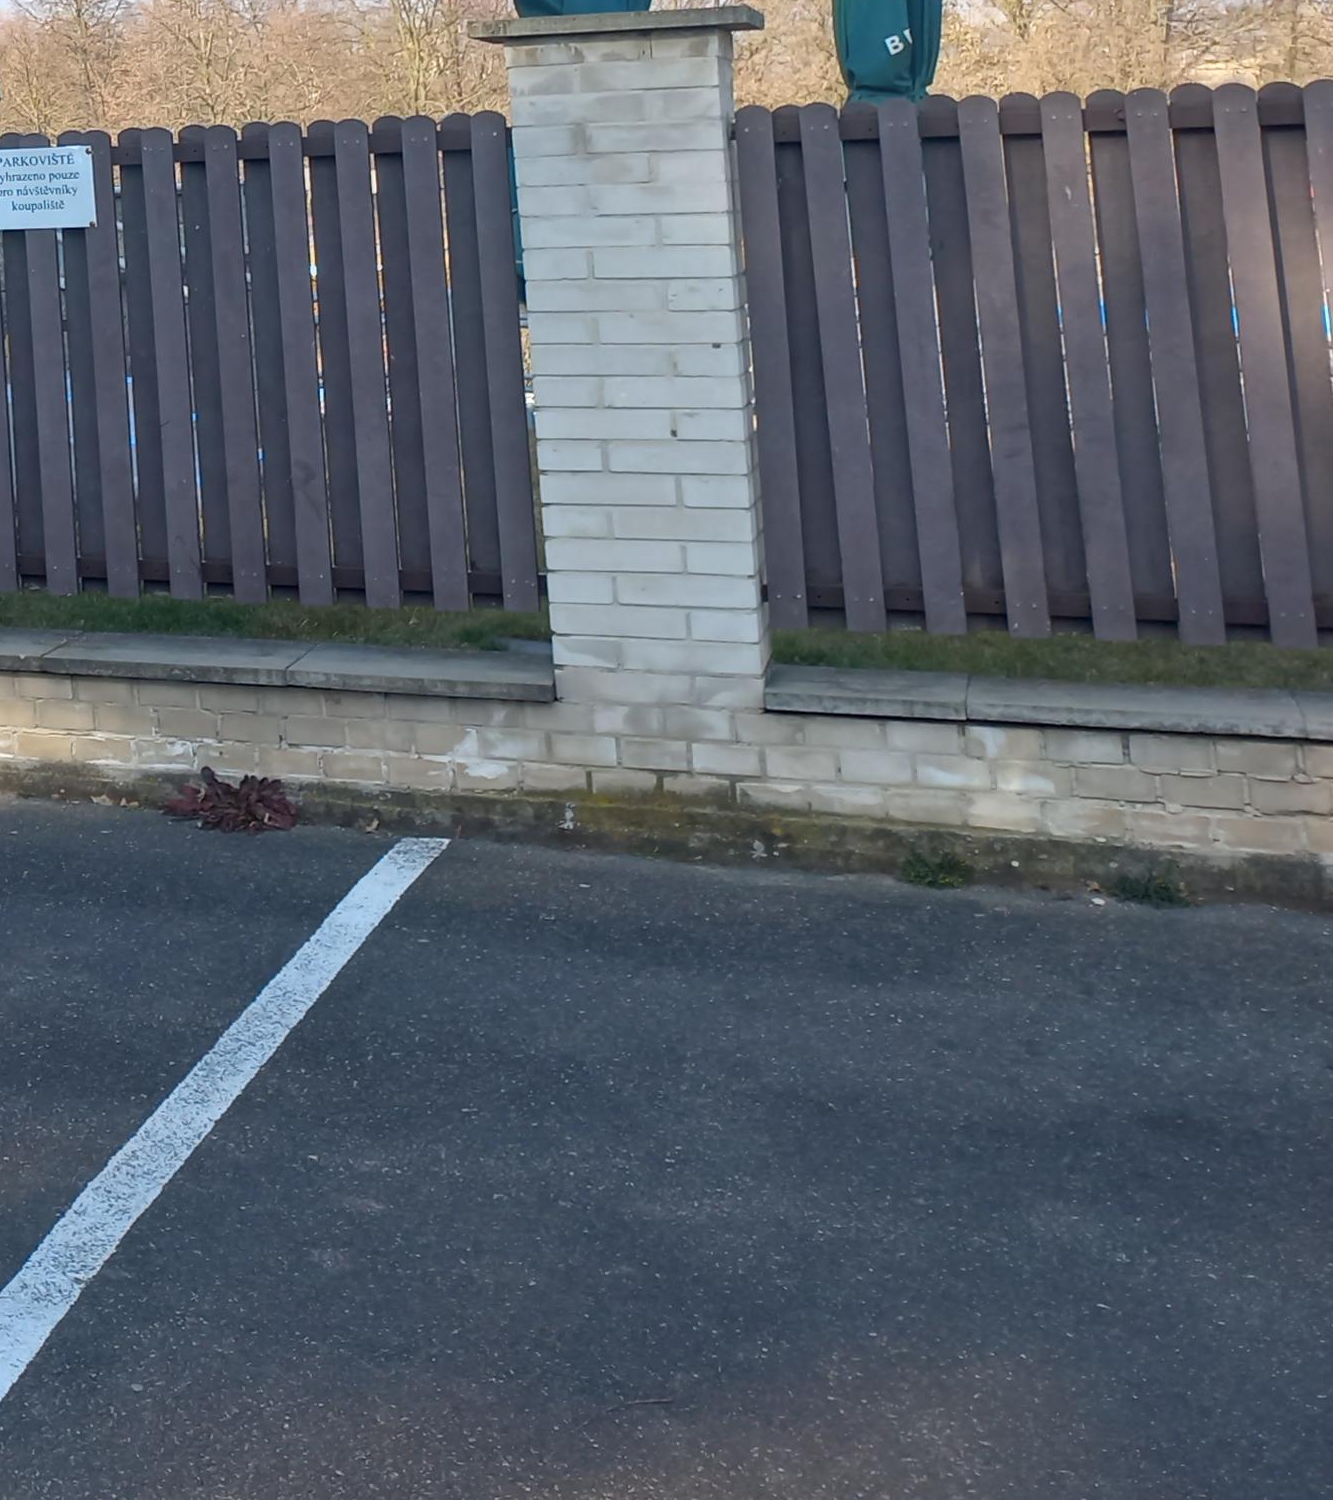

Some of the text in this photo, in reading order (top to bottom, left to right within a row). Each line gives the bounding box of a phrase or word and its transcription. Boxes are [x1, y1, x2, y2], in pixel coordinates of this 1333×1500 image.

[49, 171, 80, 183] pouze
[16, 185, 78, 198] návštěvníky
[11, 200, 65, 213] koupaliště
